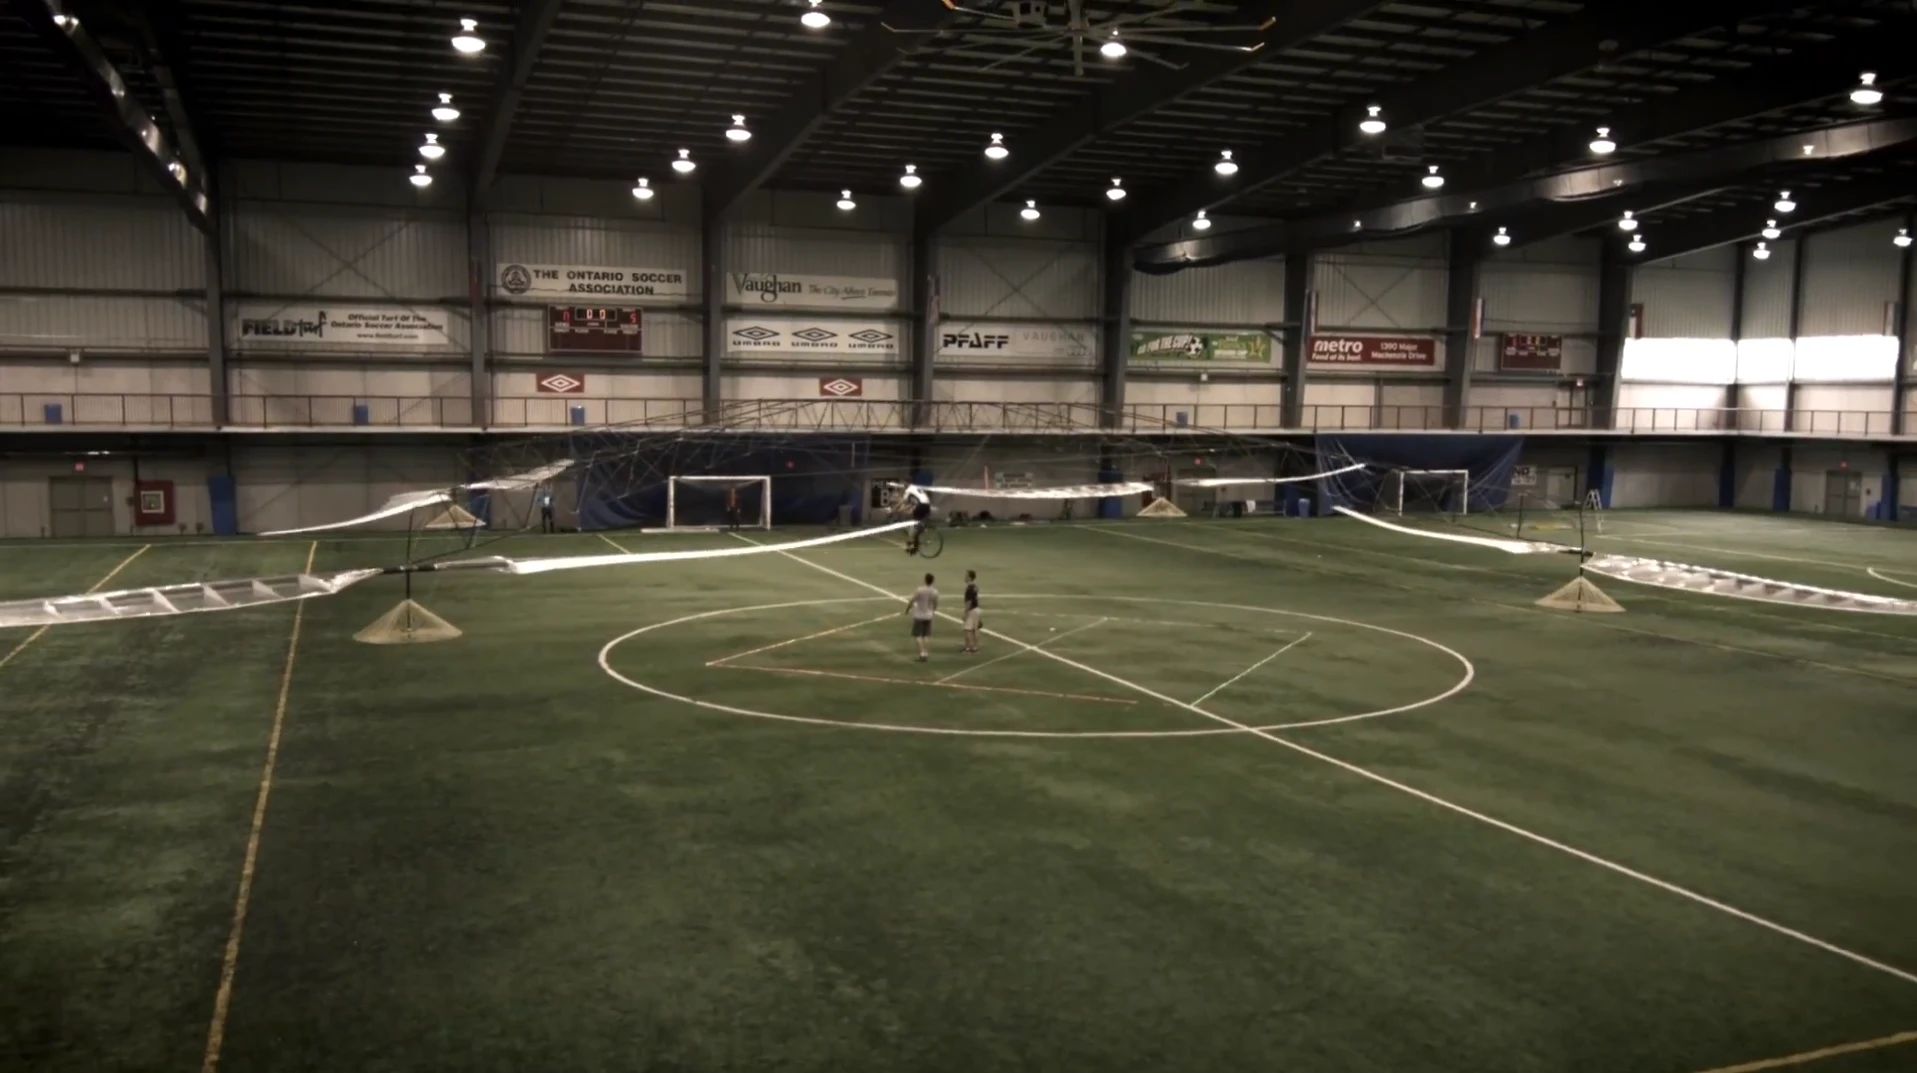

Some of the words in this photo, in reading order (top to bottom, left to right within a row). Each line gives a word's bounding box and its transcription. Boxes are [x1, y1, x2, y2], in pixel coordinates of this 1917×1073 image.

[533, 270, 559, 280] THE
[566, 271, 624, 282] ONTARIO
[631, 273, 682, 284] SOCCER
[569, 283, 654, 295] ASSOCIATION
[732, 274, 802, 303] Vaughan
[943, 332, 1009, 349] PFAFF
[1314, 339, 1363, 353] metro
[1408, 352, 1427, 360] Drive
